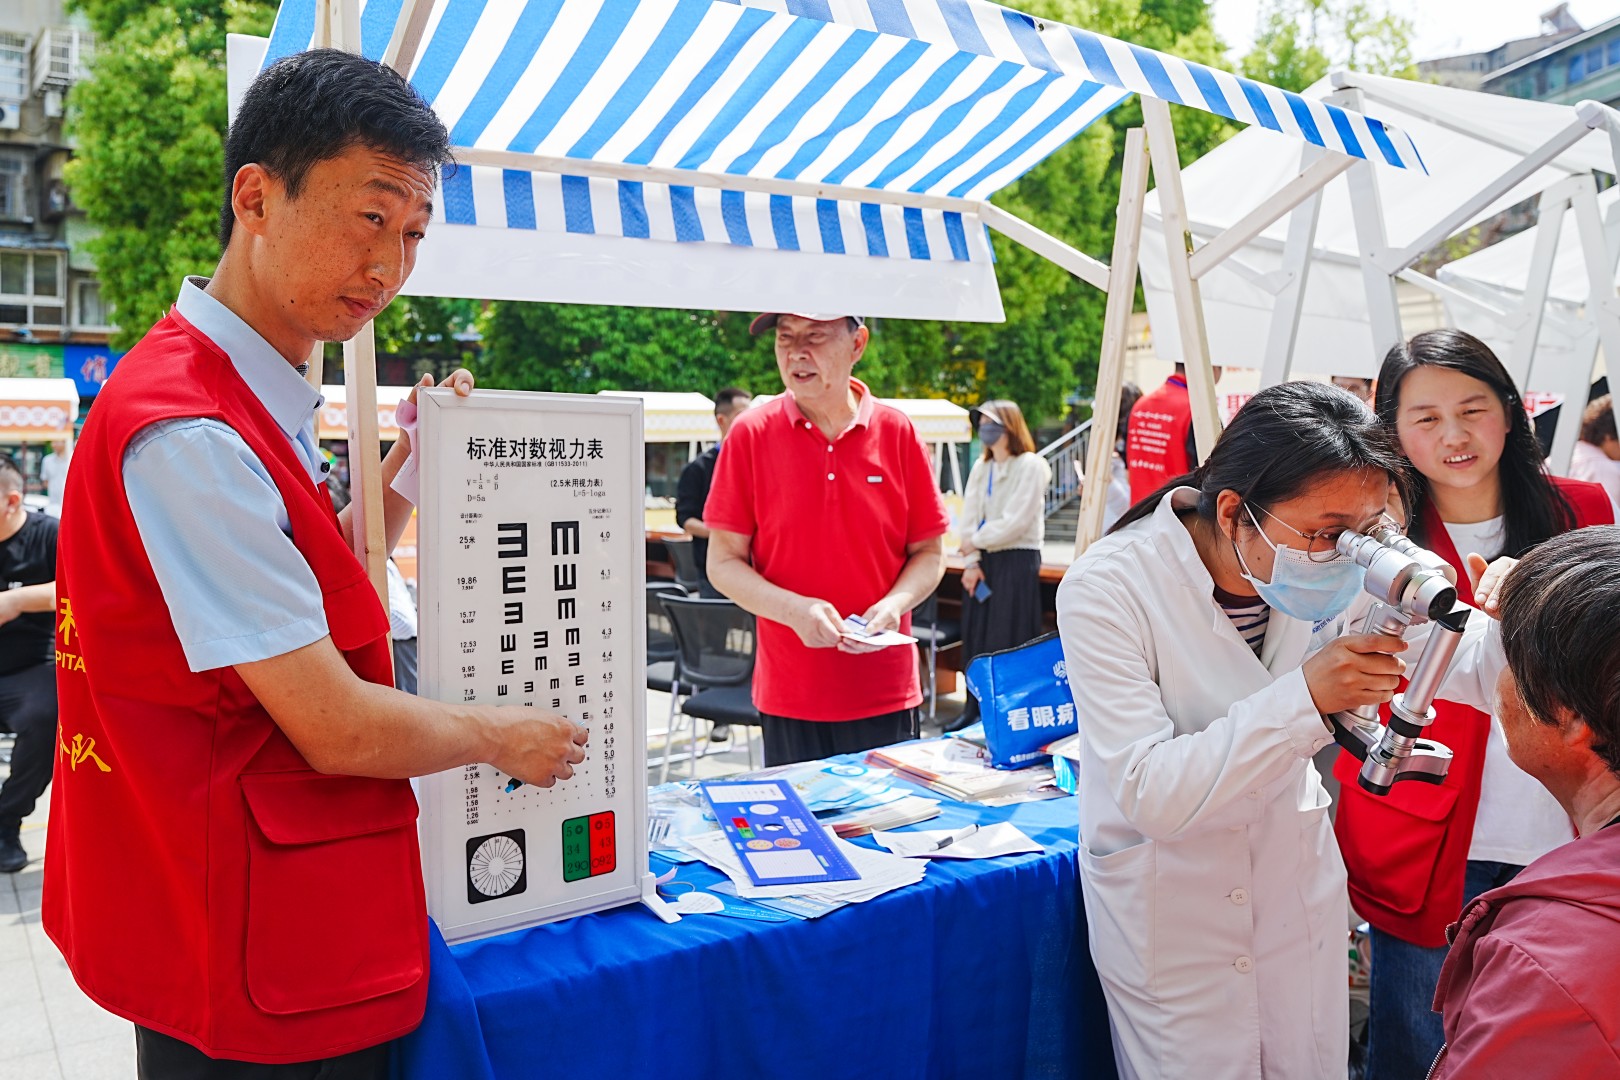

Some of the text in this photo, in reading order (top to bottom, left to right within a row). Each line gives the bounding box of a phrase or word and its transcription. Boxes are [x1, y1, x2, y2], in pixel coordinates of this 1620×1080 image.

[467, 437, 604, 460] 标准对数视力表
[459, 536, 476, 544] 25米
[1007, 702, 1074, 732] 看眼病
[605, 775, 616, 783] 5.2
[465, 787, 479, 795] 1.98
[606, 787, 616, 795] 5.3
